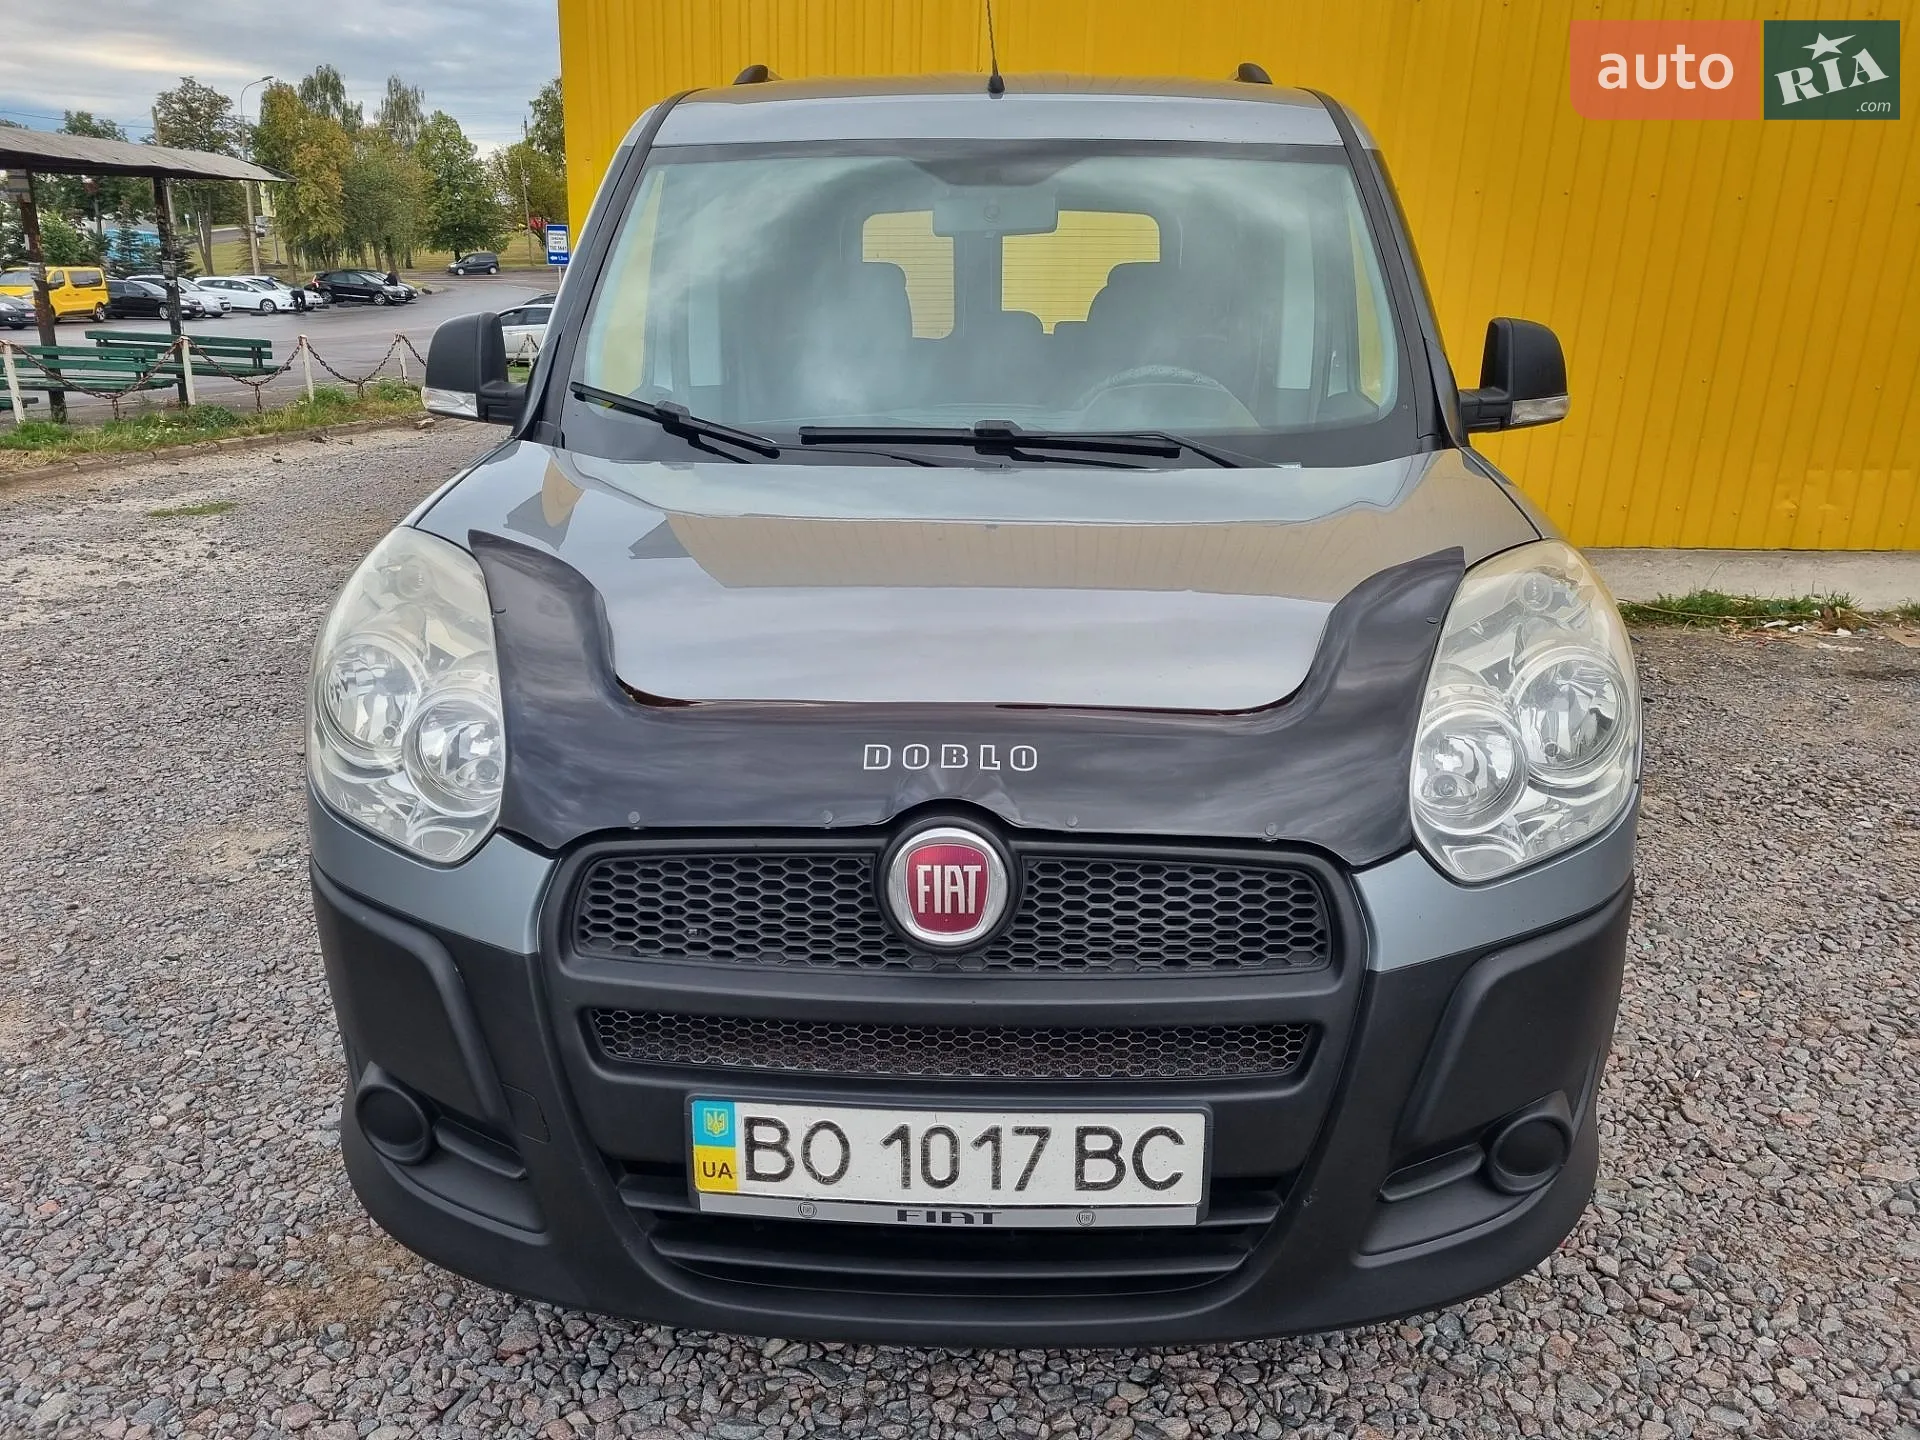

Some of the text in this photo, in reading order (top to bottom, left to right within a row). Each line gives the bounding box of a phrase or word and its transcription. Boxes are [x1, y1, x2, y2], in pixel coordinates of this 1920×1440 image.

[863, 743, 1038, 771] DOBLO
[916, 864, 982, 914] FIAT
[743, 1115, 1186, 1192] BO 1017 BC
[702, 1161, 734, 1179] UA
[897, 1209, 1002, 1225] FIAT
